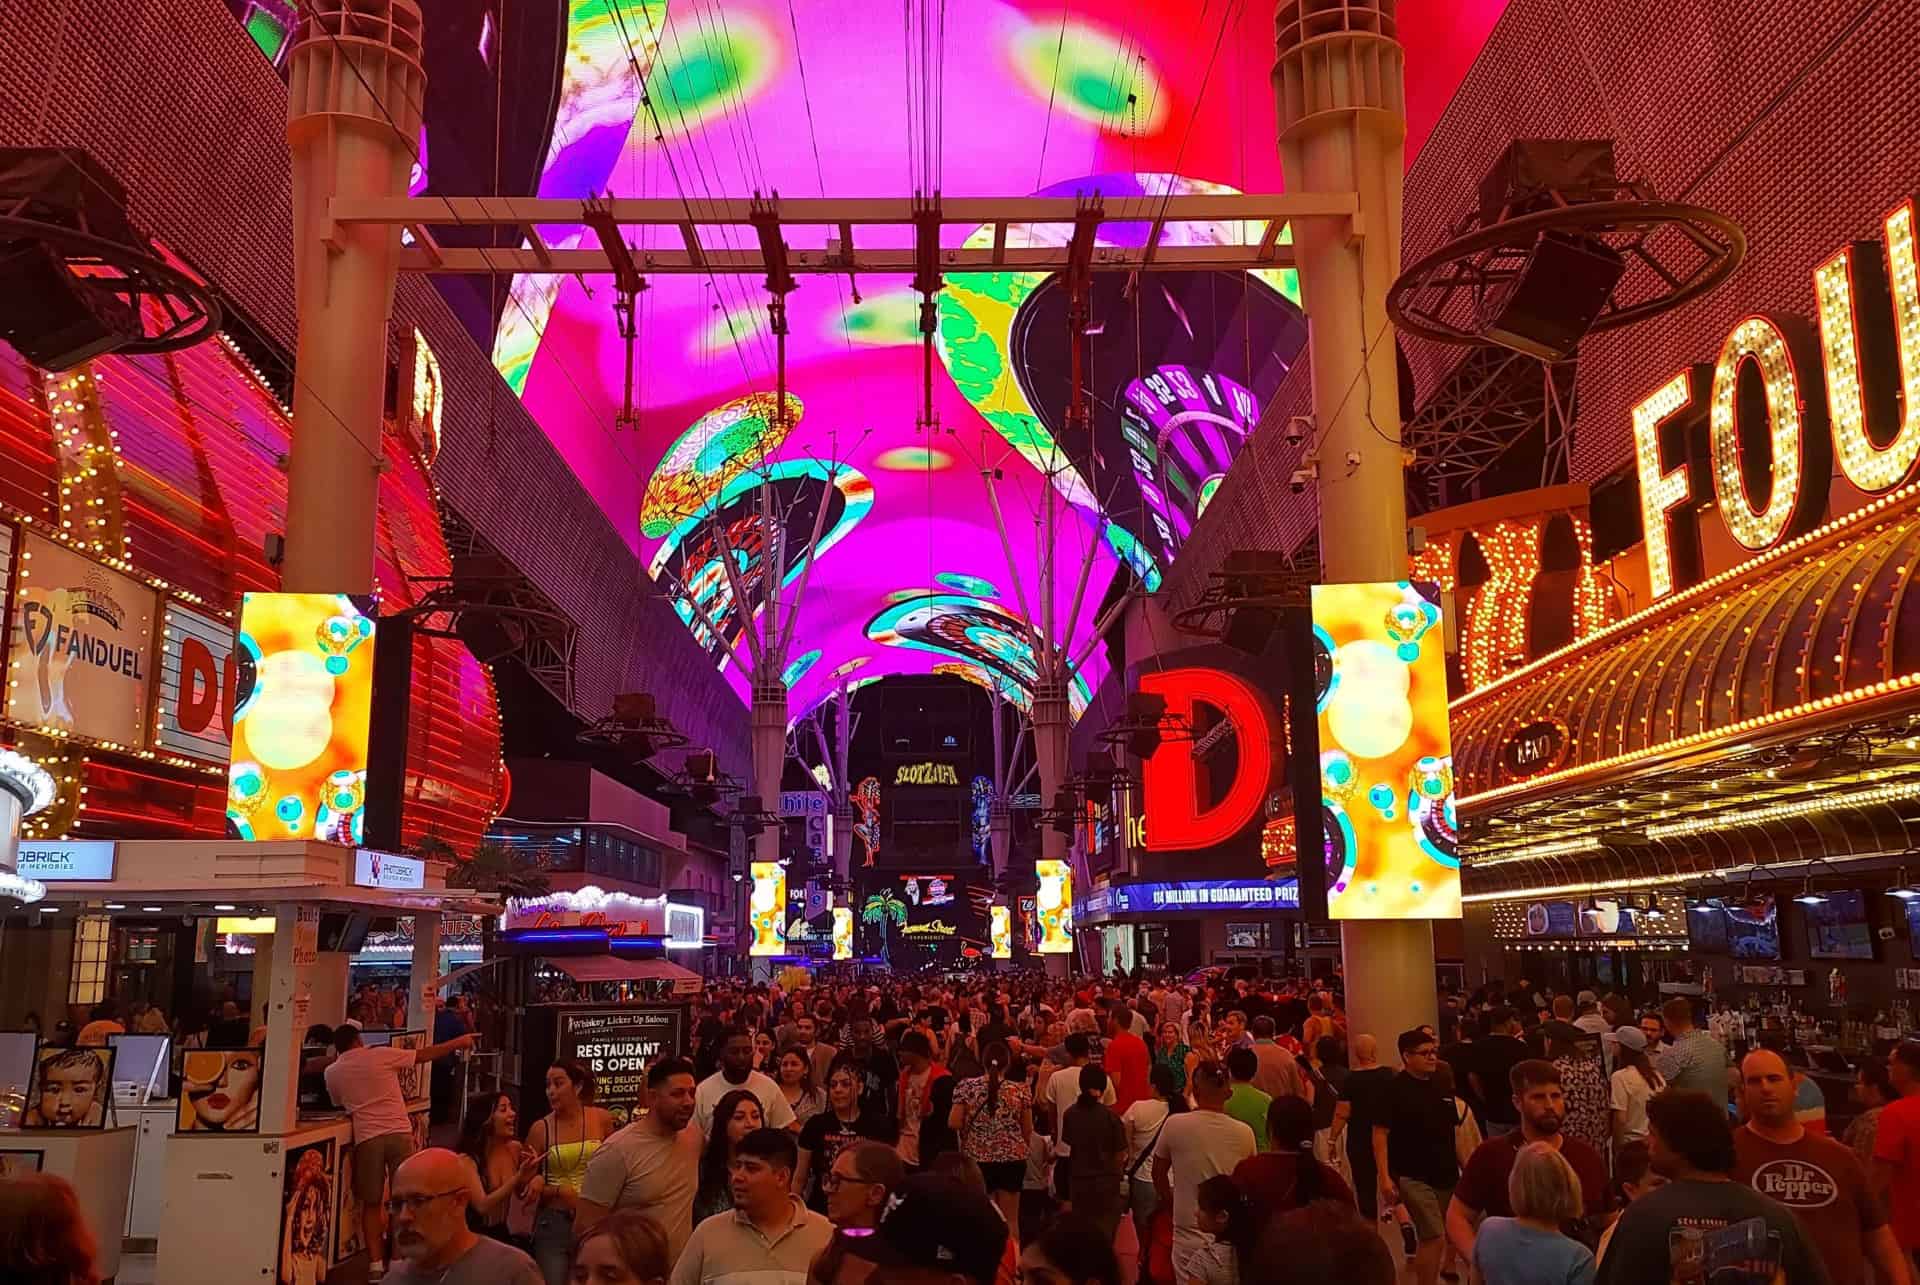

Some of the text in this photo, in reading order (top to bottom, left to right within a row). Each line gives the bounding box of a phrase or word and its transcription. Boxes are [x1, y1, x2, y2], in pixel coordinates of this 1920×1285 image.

[56, 624, 142, 680] FANDUEL
[1140, 668, 1271, 851] D
[780, 794, 823, 813] hite
[1166, 889, 1197, 904] MILLION
[1199, 889, 1209, 903] IN
[1210, 887, 1273, 903] GUARANTEED
[1275, 886, 1299, 901] PRIZ
[607, 1015, 632, 1025] Licker
[633, 1015, 643, 1025] Up
[645, 1015, 669, 1024] Saloon
[577, 1043, 661, 1058] RESTAURANT
[591, 1058, 645, 1072] IS OPEN
[1783, 1163, 1816, 1182] Dr
[1763, 1172, 1833, 1201] Pepper
